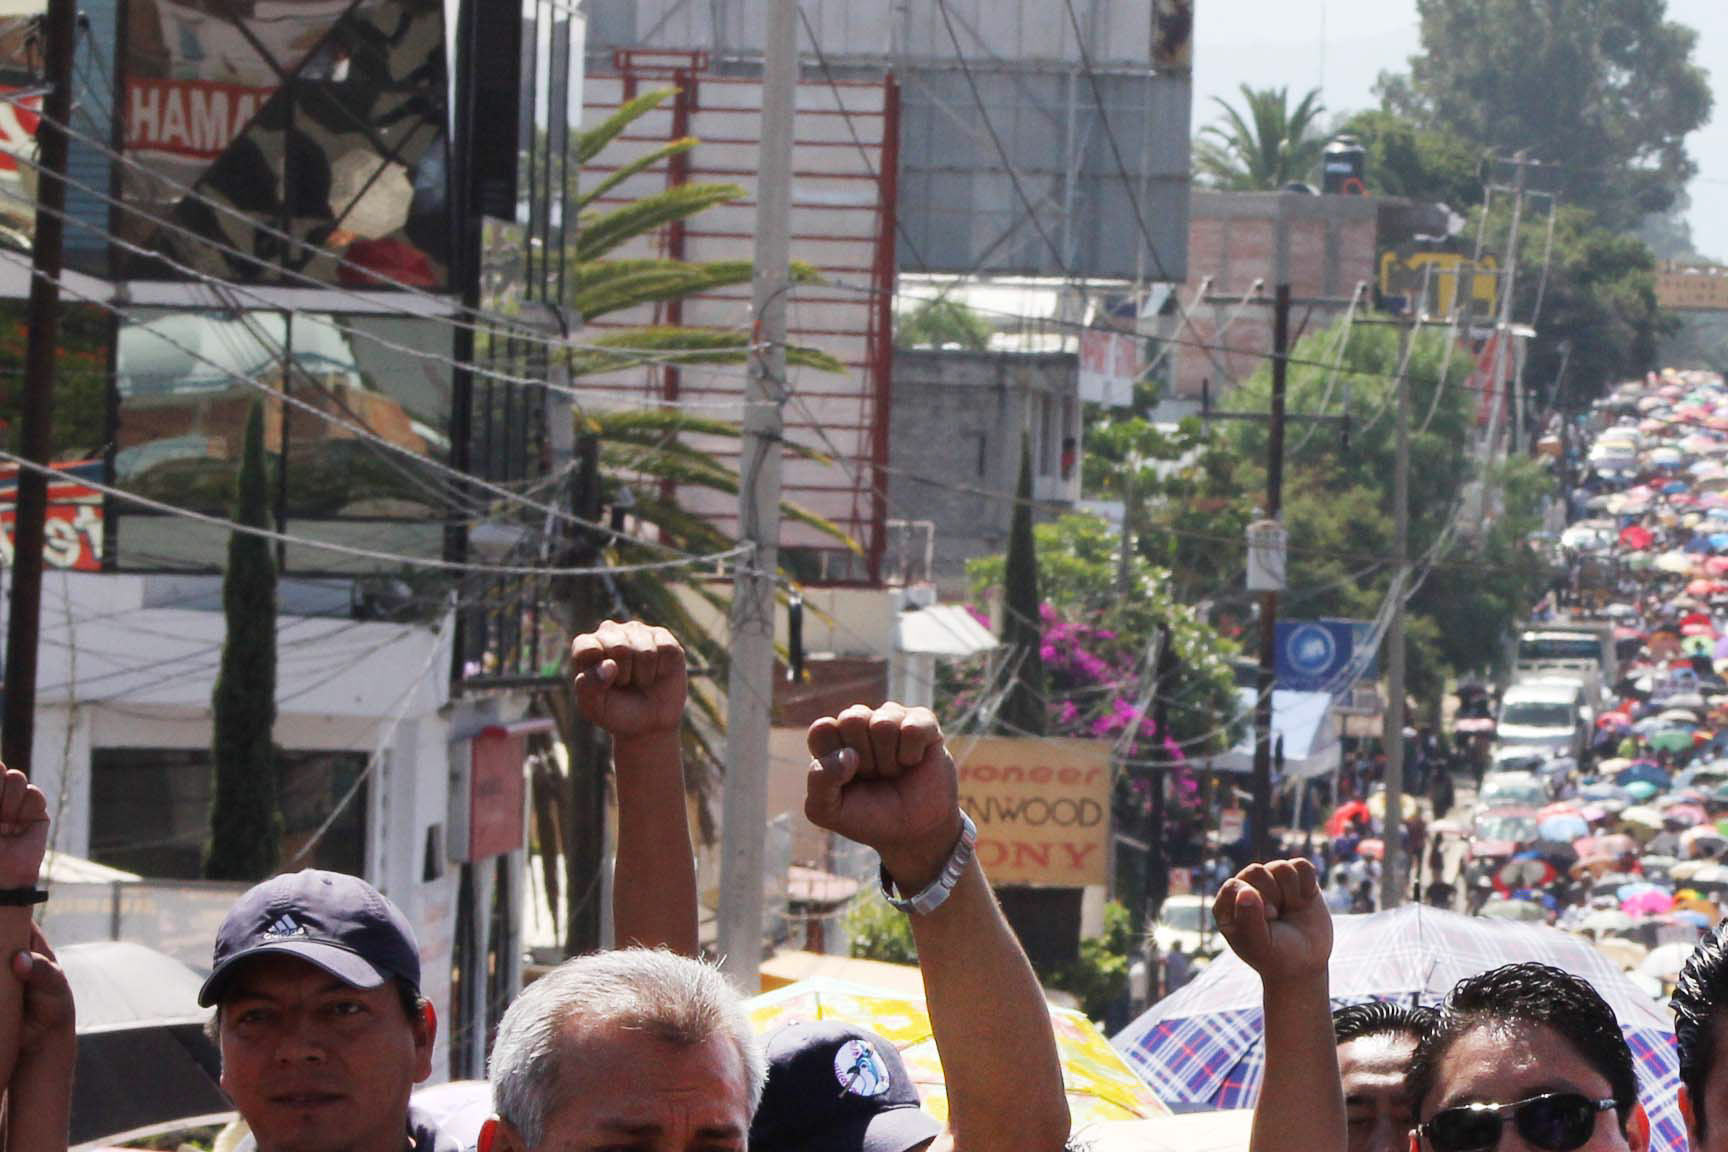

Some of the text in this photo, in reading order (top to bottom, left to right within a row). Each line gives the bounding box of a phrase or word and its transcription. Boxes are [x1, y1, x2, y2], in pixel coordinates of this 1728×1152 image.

[960, 764, 1103, 785] ioneer
[960, 796, 1103, 827] NWOOD
[974, 838, 1098, 870] ONY
